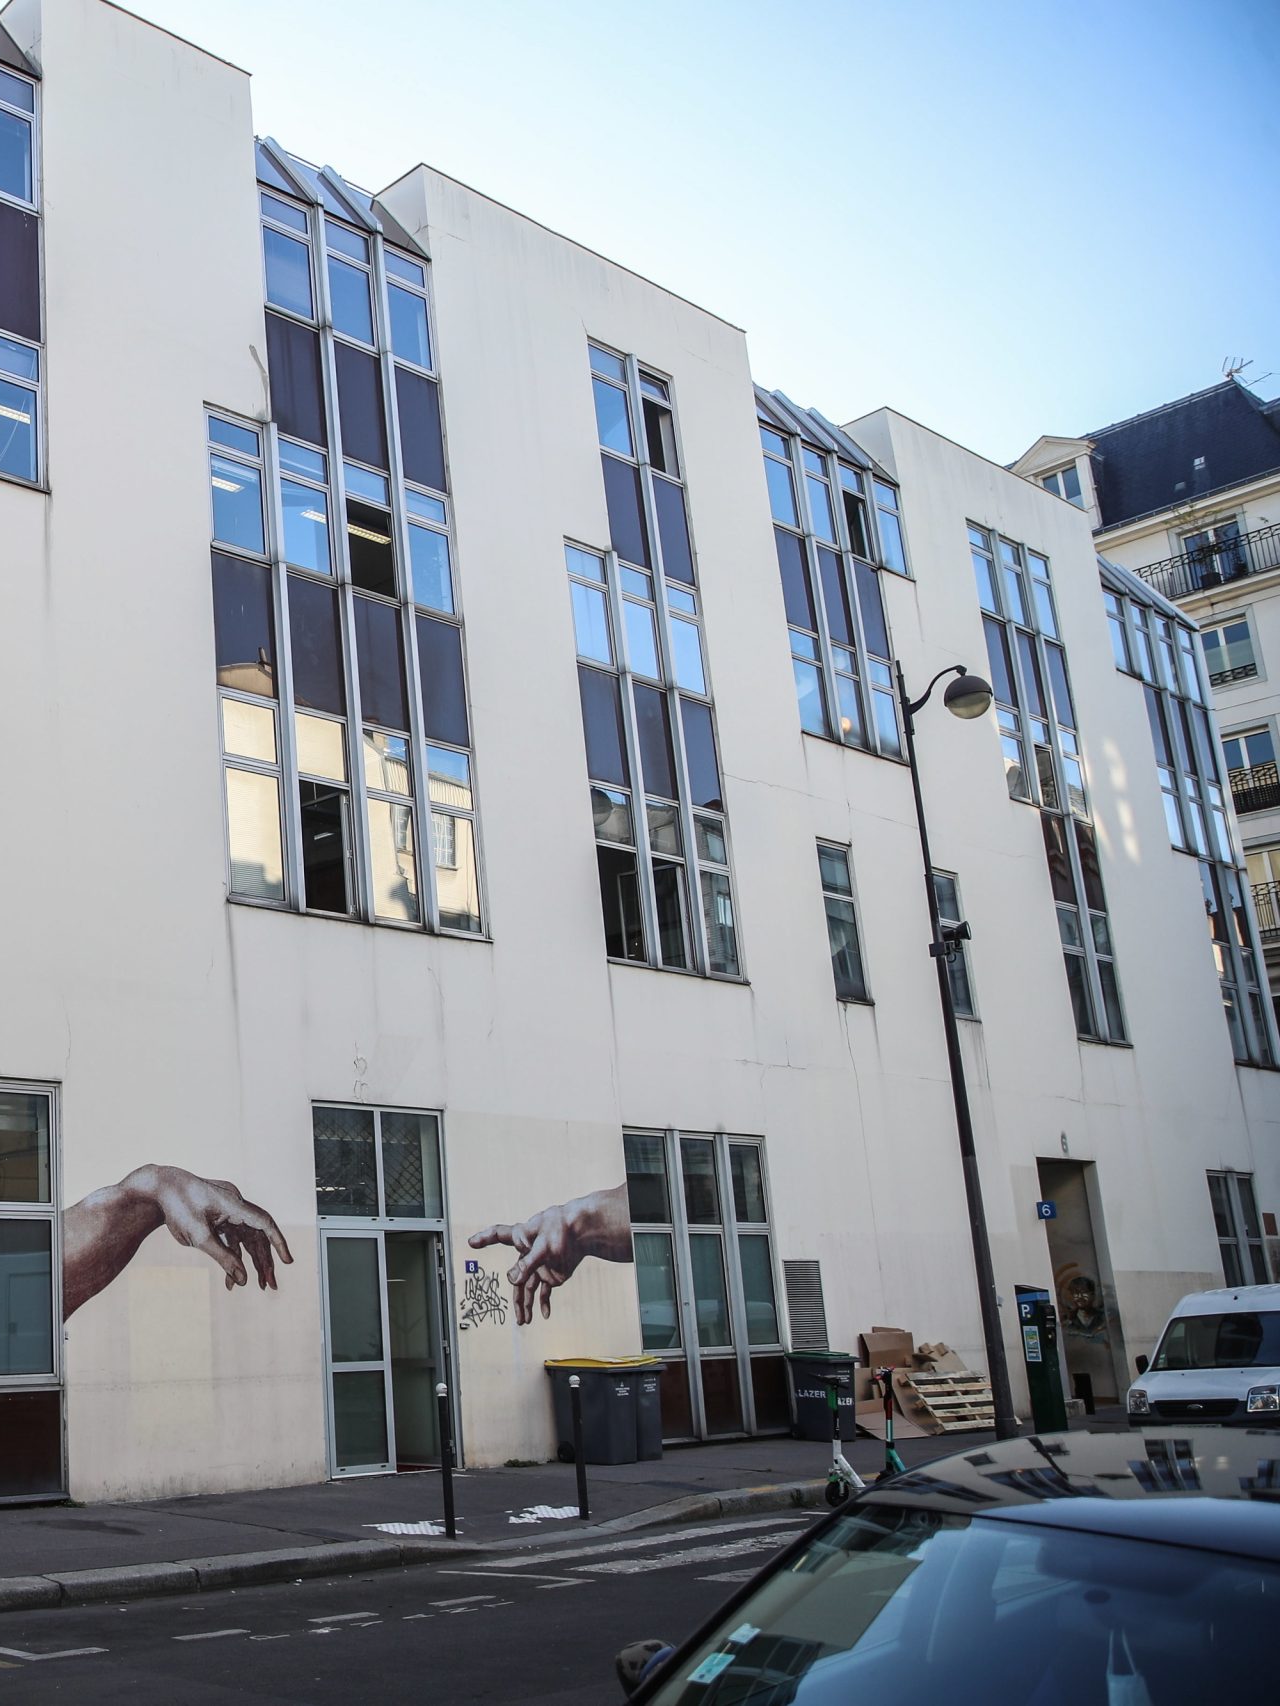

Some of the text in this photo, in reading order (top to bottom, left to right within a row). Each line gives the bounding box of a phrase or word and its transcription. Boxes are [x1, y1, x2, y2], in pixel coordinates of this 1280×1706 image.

[1041, 1204, 1052, 1216] 6
[468, 1262, 475, 1272] 8
[1021, 1304, 1030, 1317] P
[797, 1389, 827, 1399] LAZER
